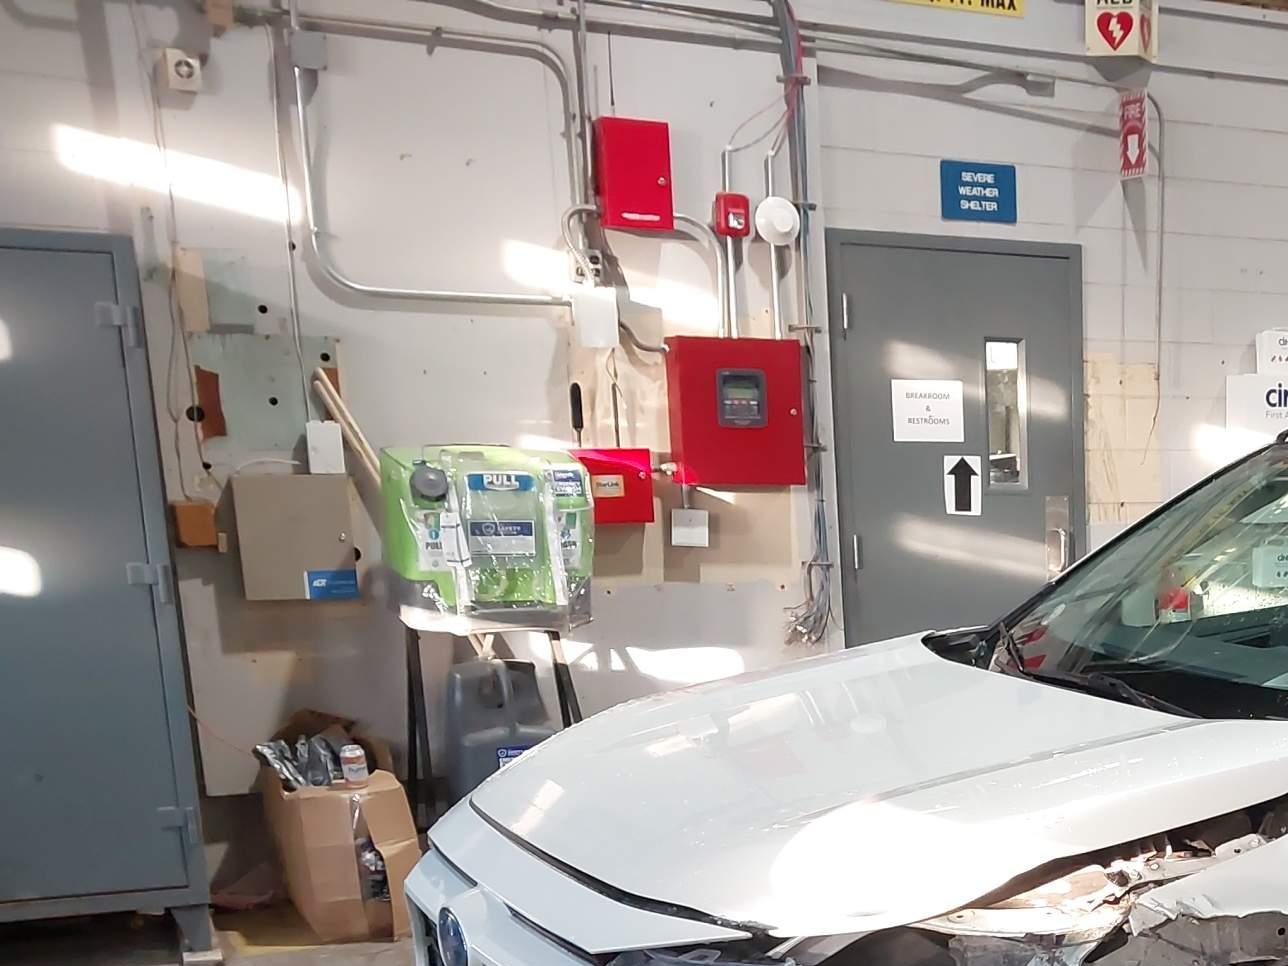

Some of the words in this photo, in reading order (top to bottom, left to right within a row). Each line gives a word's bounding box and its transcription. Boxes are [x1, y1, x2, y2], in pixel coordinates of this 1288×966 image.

[961, 171, 995, 184] SEVERE
[958, 185, 999, 198] WEATHER
[960, 199, 998, 212] SHELTER
[905, 392, 950, 400] BREAKROOM
[925, 404, 931, 412] &
[907, 417, 950, 425] RESTROOMS
[483, 474, 520, 488] PULL
